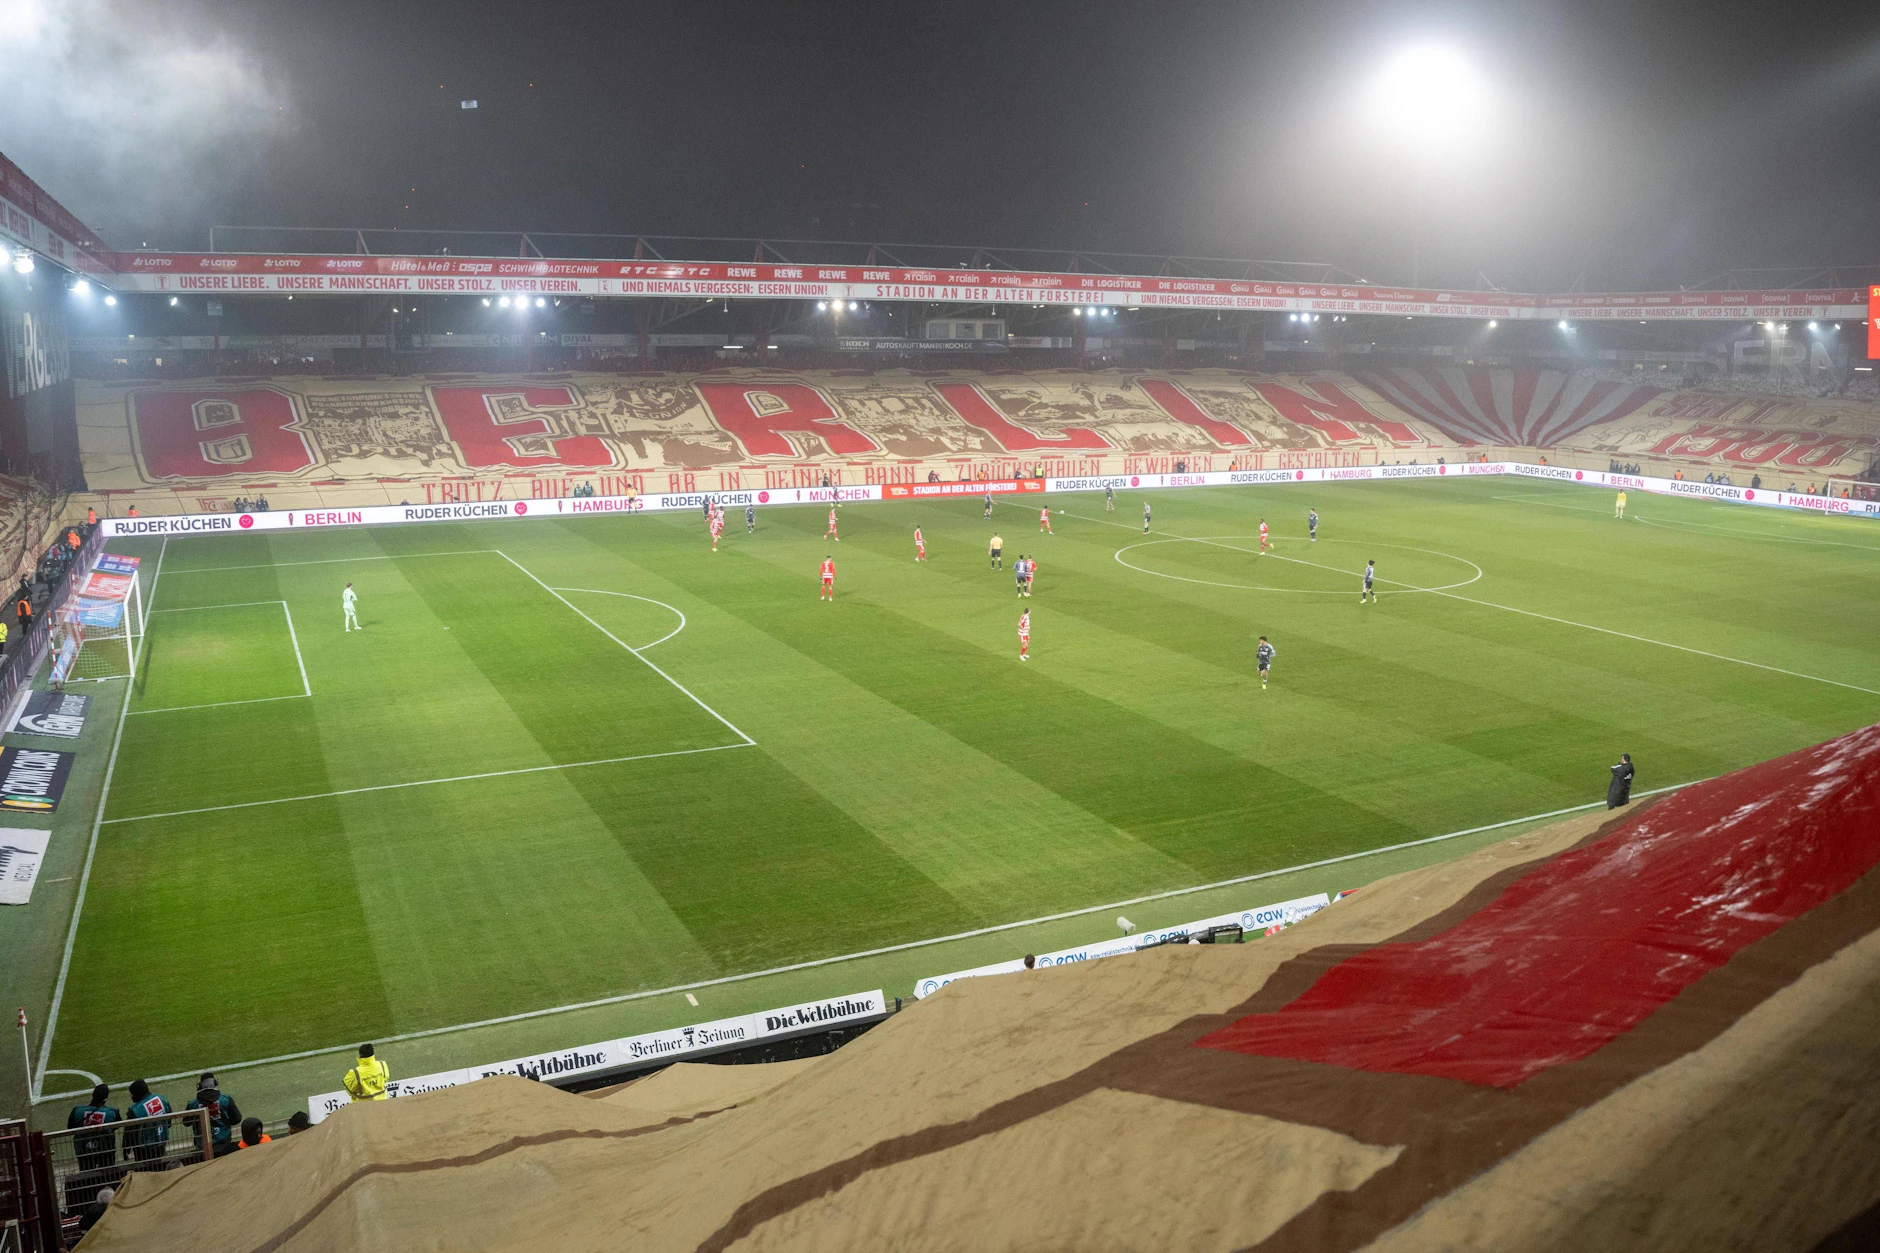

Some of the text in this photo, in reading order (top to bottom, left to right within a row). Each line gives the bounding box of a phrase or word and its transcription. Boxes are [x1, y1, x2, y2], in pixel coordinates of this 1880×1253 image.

[145, 258, 171, 267] LOTTO
[211, 259, 237, 267] LOTTO
[275, 259, 301, 267] LOTTO
[337, 260, 362, 268] LOTTO
[499, 264, 599, 275] SCHWIMMBADTECHNIK
[727, 268, 757, 278] REWE
[774, 269, 803, 279] REWE
[818, 270, 846, 280] REWE
[863, 271, 890, 281] REWE
[911, 272, 936, 282] raisin
[955, 274, 980, 284] raisin
[997, 275, 1021, 285] raisin
[1039, 277, 1061, 286] raisin
[180, 277, 581, 292] UNSERE LIEBE. UNSERE MANNSCHAFT. UNSER STOLZ. UNSER VEREIN.
[622, 281, 828, 296] UND NIEMALS VERGESSEN: EISERN UNION!
[1081, 279, 1141, 289] DIE LOGISTIKER
[1159, 281, 1215, 291] DIE LOGISTIKER
[876, 286, 934, 298] STADION
[942, 287, 959, 299] AN
[965, 288, 988, 300] DER
[995, 288, 1033, 301] ALTEN
[1141, 294, 1287, 308] UND NIEMALS VERGESSEN: EISERN UNION!
[1312, 299, 1337, 310] UNSERE
[1337, 300, 1357, 311] LIEBE.
[1359, 301, 1384, 312] UNSERE
[1385, 302, 1426, 314] MANNSCHAFT.
[1429, 304, 1449, 315] UNSER
[1470, 306, 1489, 316] UNSER
[1568, 309, 1593, 318] UNSERE
[1617, 309, 1643, 318] UNSERE
[1697, 308, 1722, 317] UNSER
[1754, 307, 1780, 317] UNSER
[1330, 469, 1372, 480] HAMBURG
[1382, 466, 1436, 478] RUDER KÜCHEN
[1469, 464, 1505, 474] MÜNCHEN
[1515, 465, 1572, 479] RUDER KÜCHEN
[421, 480, 504, 504] TROTZ
[532, 478, 574, 499] AUF
[669, 472, 696, 494] AB
[720, 471, 740, 492] IN
[766, 468, 842, 489] DEINEM
[865, 466, 915, 486] BANN
[1234, 454, 1263, 471] NEU
[1279, 451, 1360, 470] GESTALTEN
[1170, 475, 1205, 486] BERLIN
[1231, 471, 1292, 483] RUDER KÜCHEN
[1611, 475, 1644, 488] BERLIN
[913, 485, 940, 495] STADION
[941, 485, 951, 493] AN
[952, 484, 964, 493] DER
[965, 483, 985, 492] ALTEN
[1056, 479, 1088, 490] RUDER
[1671, 482, 1741, 499] RUDER KÜCHEN
[810, 489, 871, 501] MÜNCHEN
[573, 499, 644, 512] HAMBURG
[662, 497, 700, 508] RUDER
[1789, 496, 1849, 512] HAMBURG
[405, 504, 508, 520] RUDER KÜCHEN
[305, 511, 362, 526] BERLIN
[115, 517, 232, 534] RUDER KÜCHEN
[1256, 909, 1283, 924] eaw
[1056, 951, 1088, 965] eaw
[765, 998, 875, 1032] Die Weltbühne
[630, 1026, 745, 1059] Berliner Zeitung
